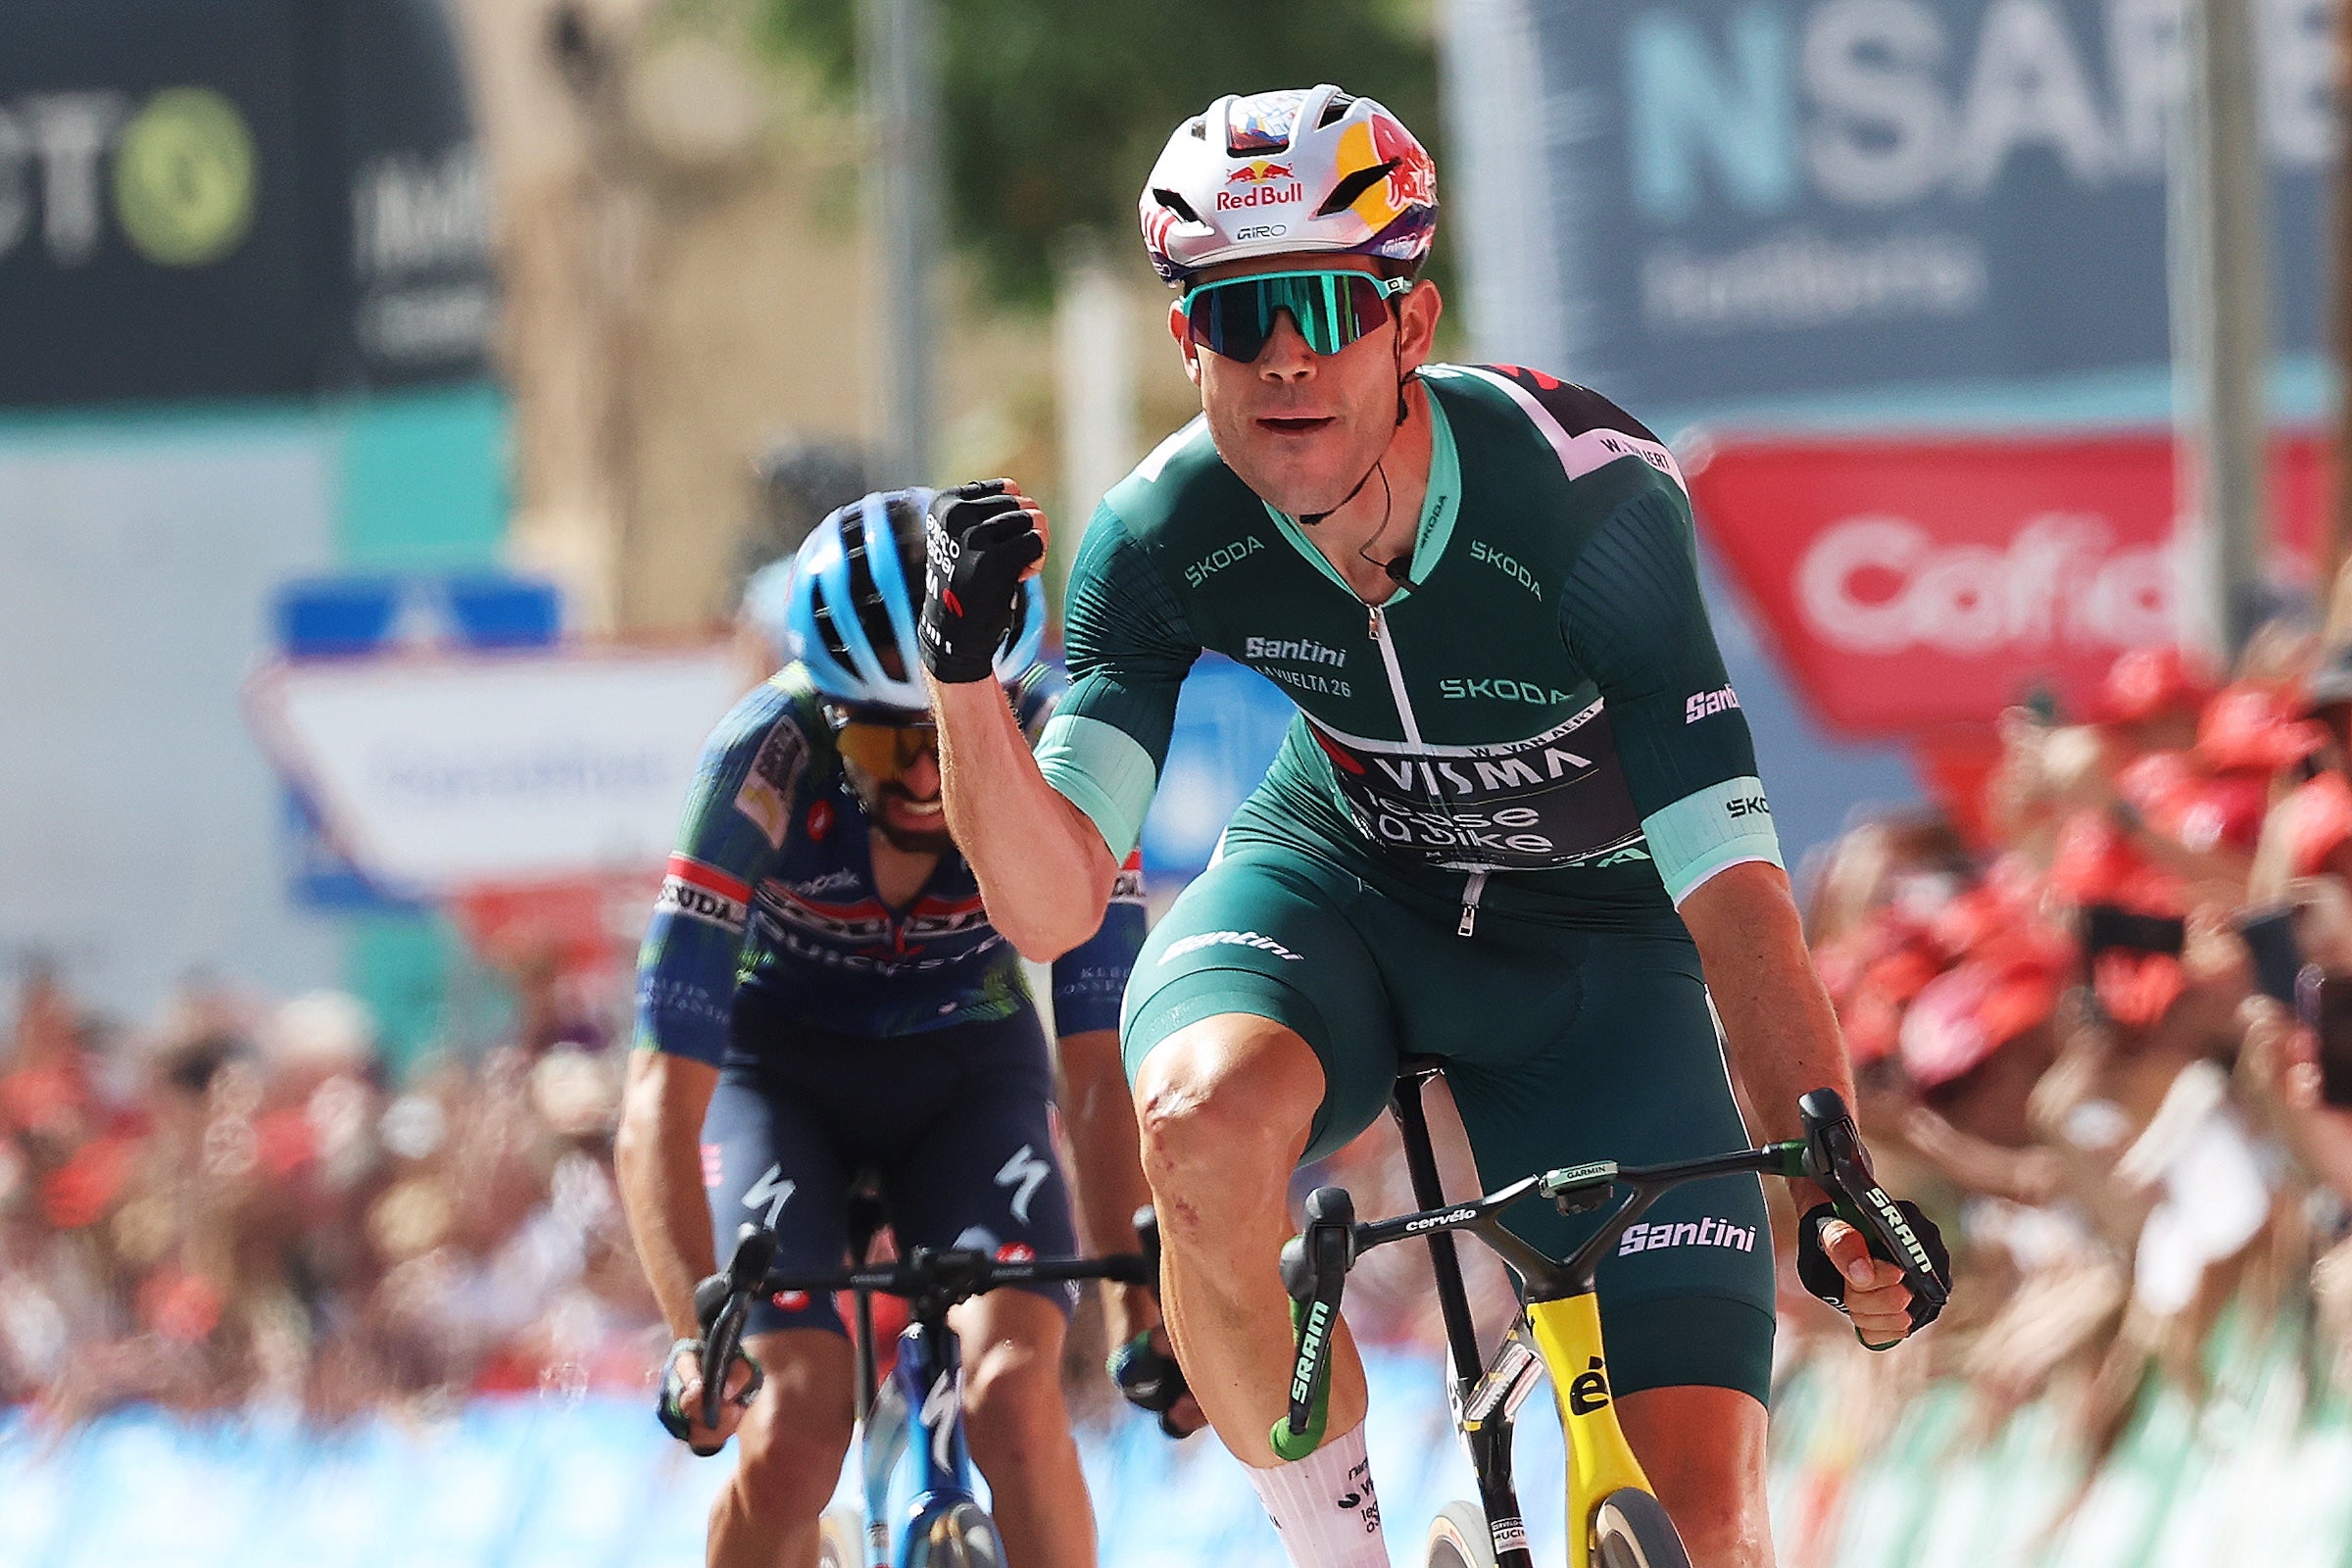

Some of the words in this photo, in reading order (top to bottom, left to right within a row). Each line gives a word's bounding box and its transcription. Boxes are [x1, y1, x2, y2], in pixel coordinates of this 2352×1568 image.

[1217, 187, 1256, 211] Red
[1261, 183, 1302, 205] Bull
[1184, 535, 1265, 588] SKODA
[1470, 540, 1543, 602] SKODA
[1245, 636, 1348, 667] Santini
[1331, 678, 1352, 698] 26
[1440, 678, 1575, 706] SKODA
[1374, 747, 1593, 796] VISMA
[1566, 1165, 1606, 1180] GARMIN
[1618, 1216, 1757, 1257] Santini
[1865, 1187, 1934, 1274] SRAM
[1291, 1300, 1331, 1405] SRAM
